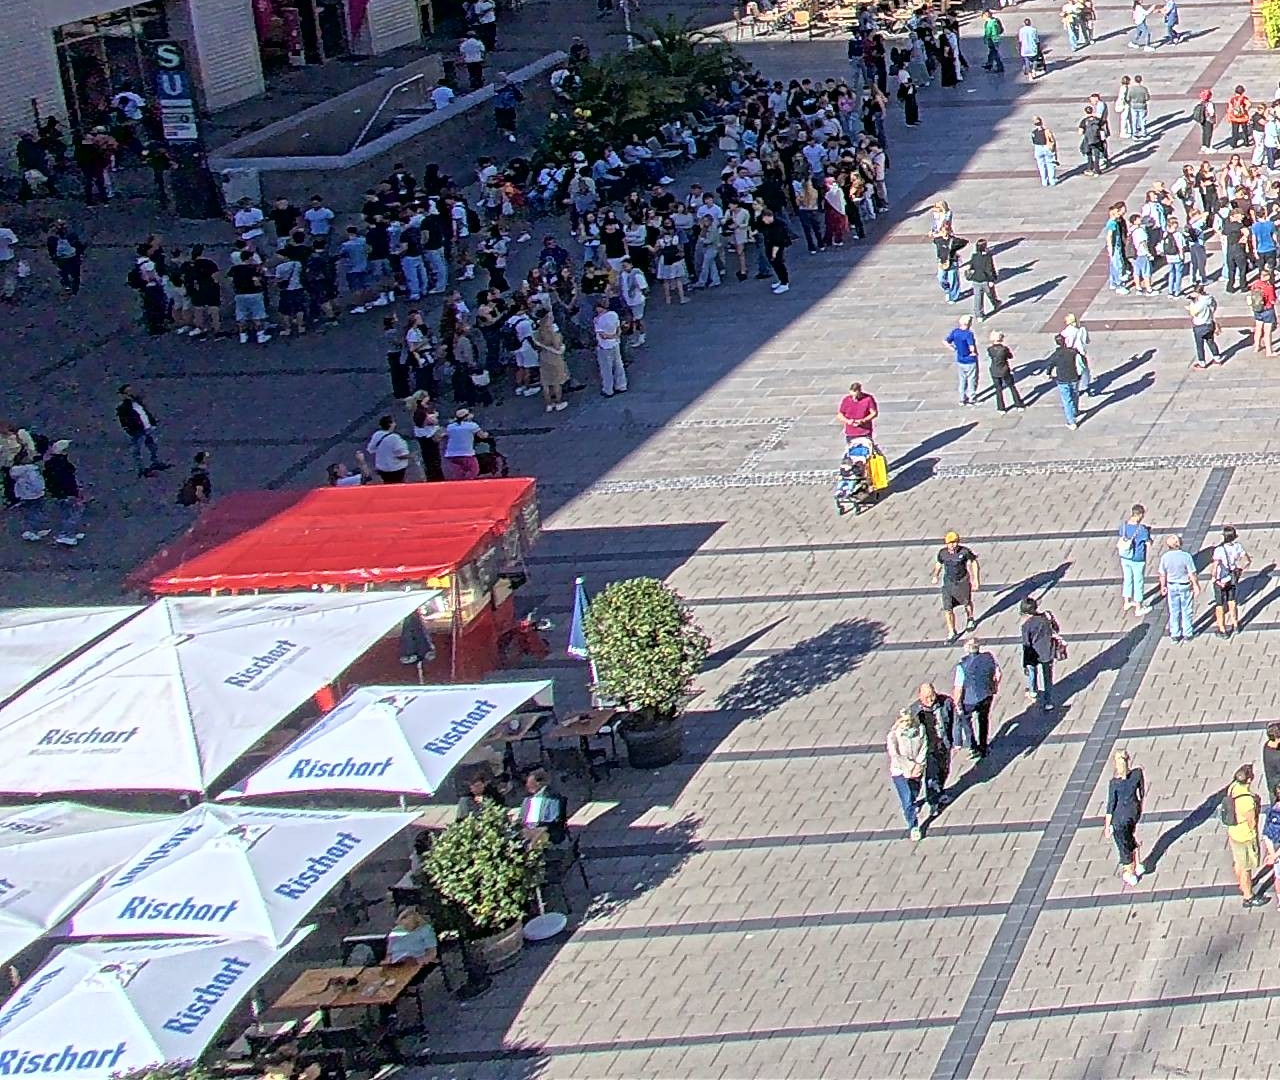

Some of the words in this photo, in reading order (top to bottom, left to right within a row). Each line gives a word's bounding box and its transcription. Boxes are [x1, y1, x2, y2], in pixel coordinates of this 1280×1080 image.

[158, 44, 180, 68] S
[162, 74, 184, 96] U
[224, 639, 297, 688] Rischart
[36, 726, 140, 746] Rischart
[423, 698, 497, 756] Rischart
[288, 756, 394, 779] Rischart
[273, 831, 362, 901] Rischart
[117, 895, 239, 923] Rischart
[162, 954, 251, 1035] Rischart
[0, 1040, 127, 1076] Rischart
